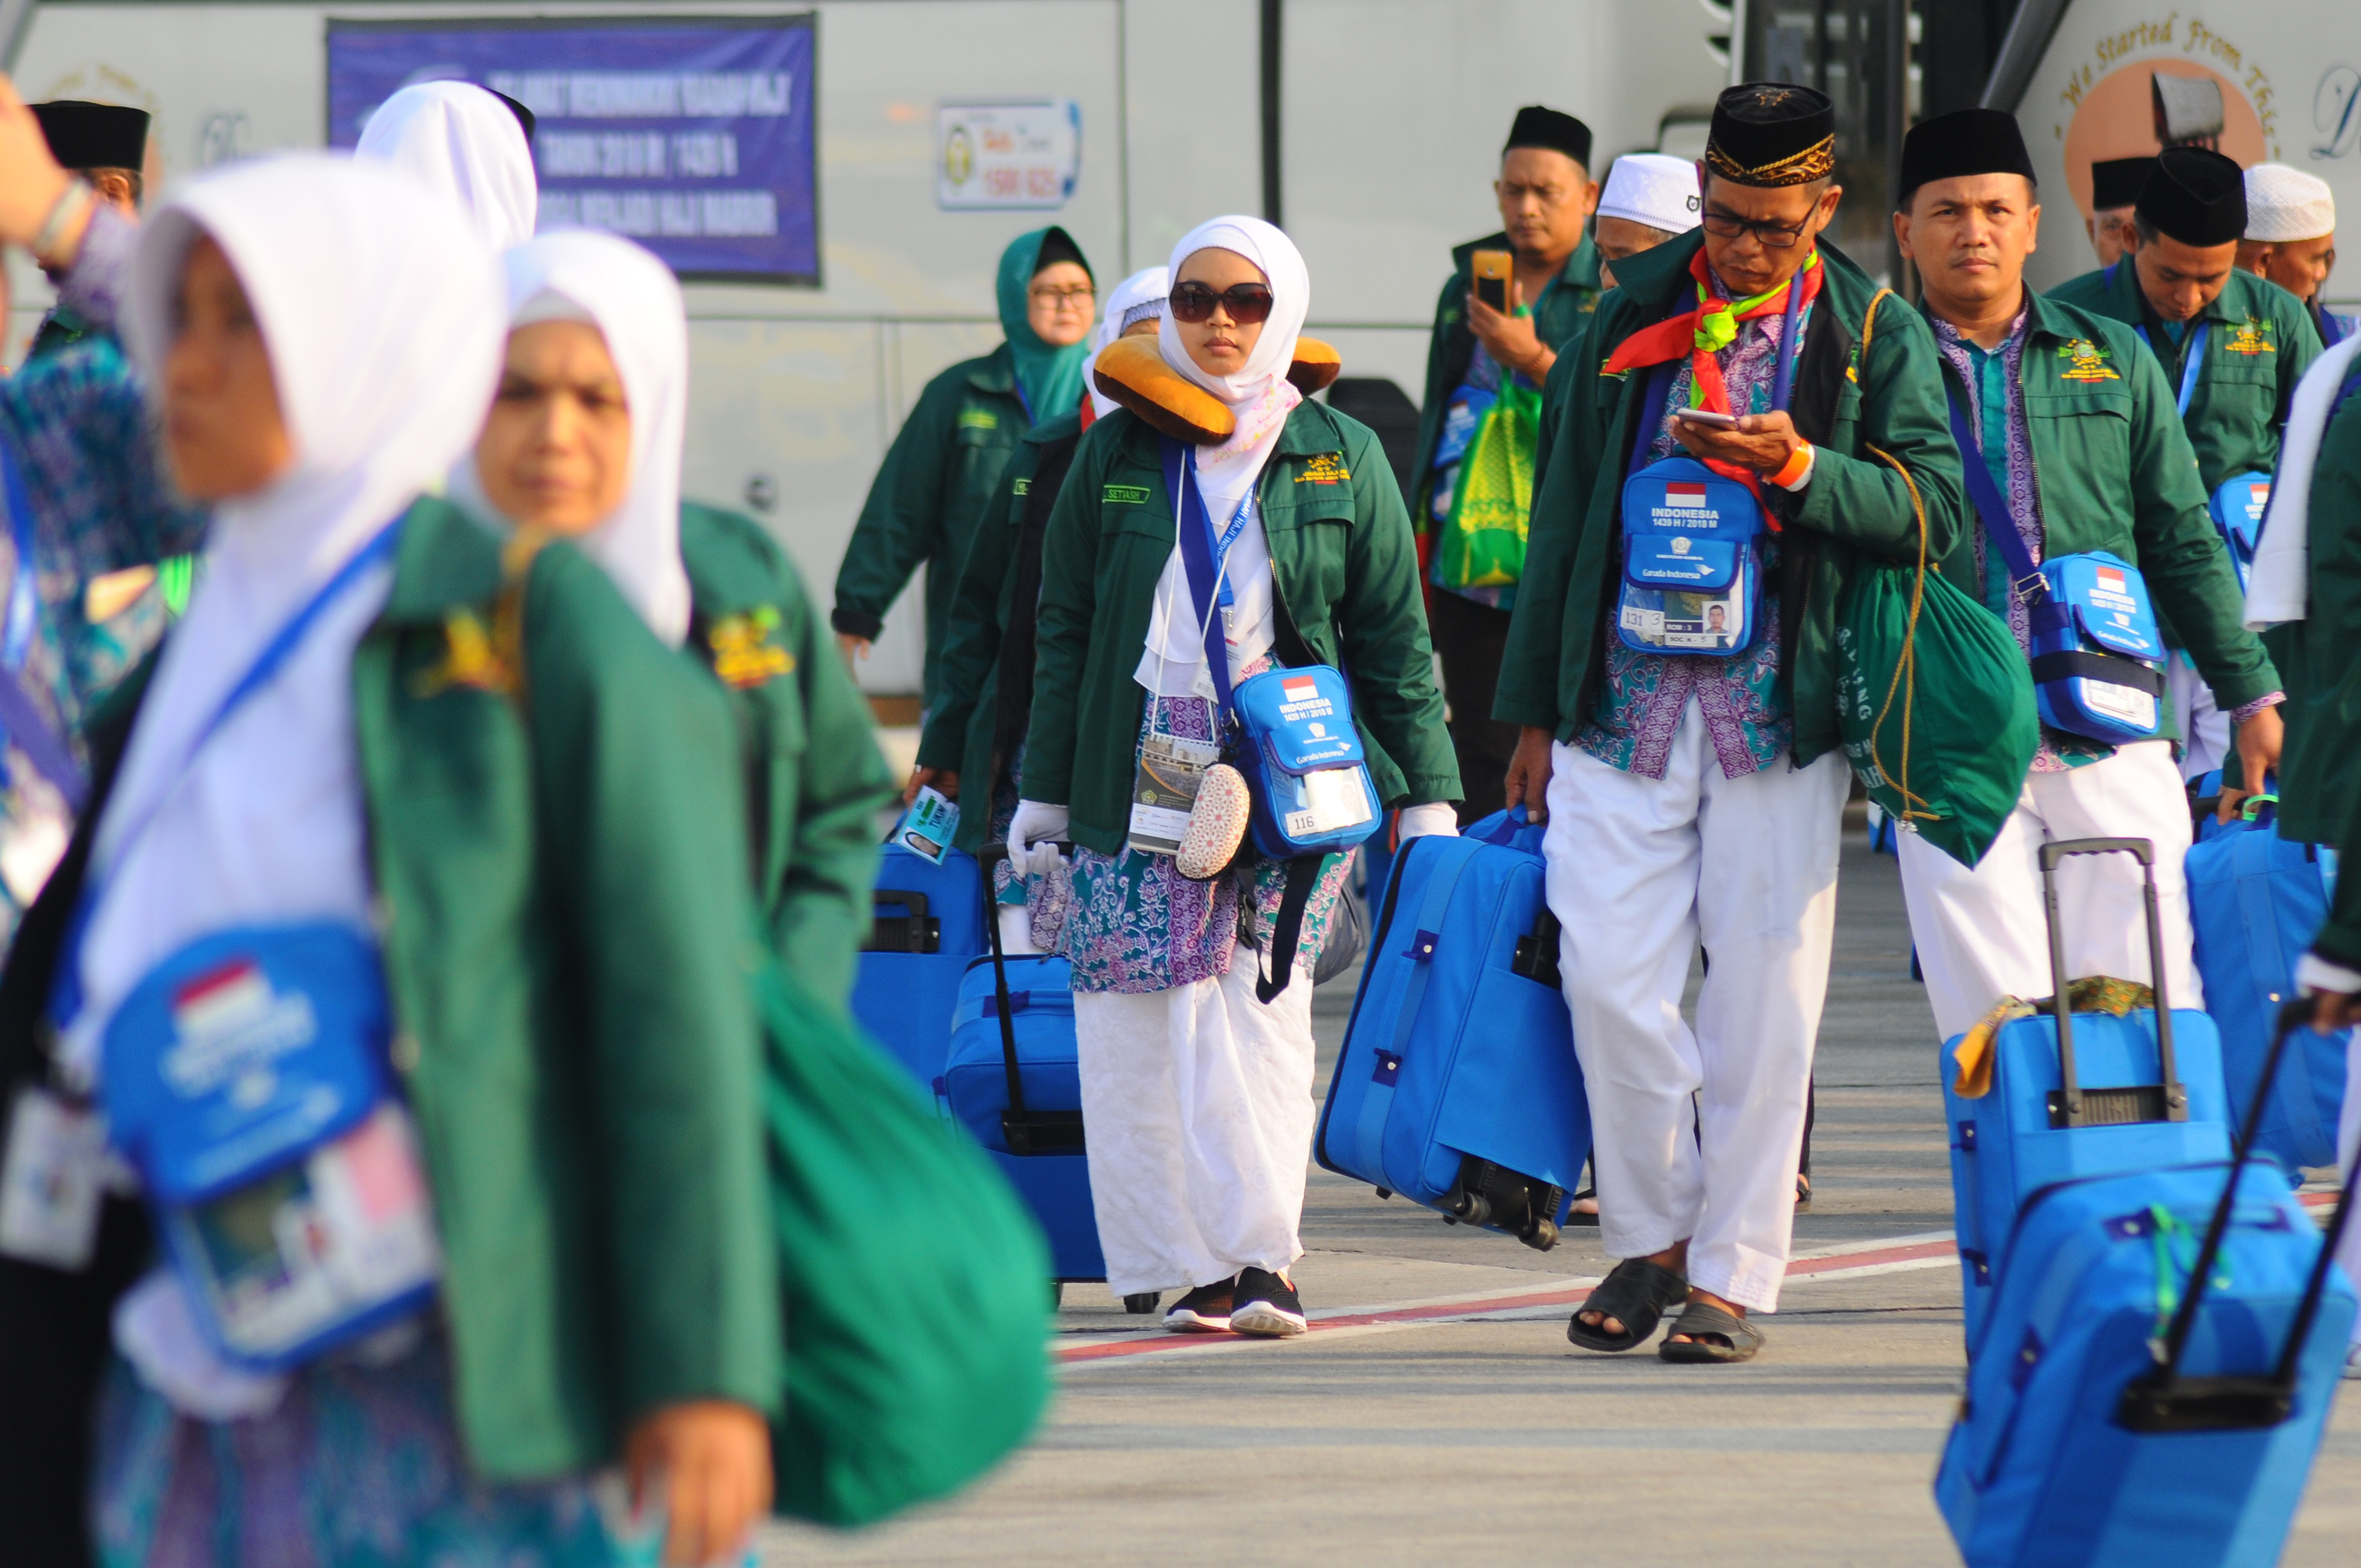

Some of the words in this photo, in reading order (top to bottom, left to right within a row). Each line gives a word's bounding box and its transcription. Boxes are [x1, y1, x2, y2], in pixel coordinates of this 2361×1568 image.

[2095, 11, 2178, 70] Started
[1652, 508, 1719, 519] INDONESIA
[1227, 516, 1245, 537] HAJI
[1653, 518, 1672, 527] 1439
[1673, 519, 1681, 527] H
[1686, 519, 1708, 528] 2018
[1708, 520, 1718, 528] M
[1626, 613, 1643, 627] 131
[1278, 698, 1332, 714] INDONESIA
[1284, 712, 1300, 722] 1439
[1299, 711, 1307, 719] H
[1310, 708, 1327, 718] 2018
[1295, 816, 1314, 830] 116
